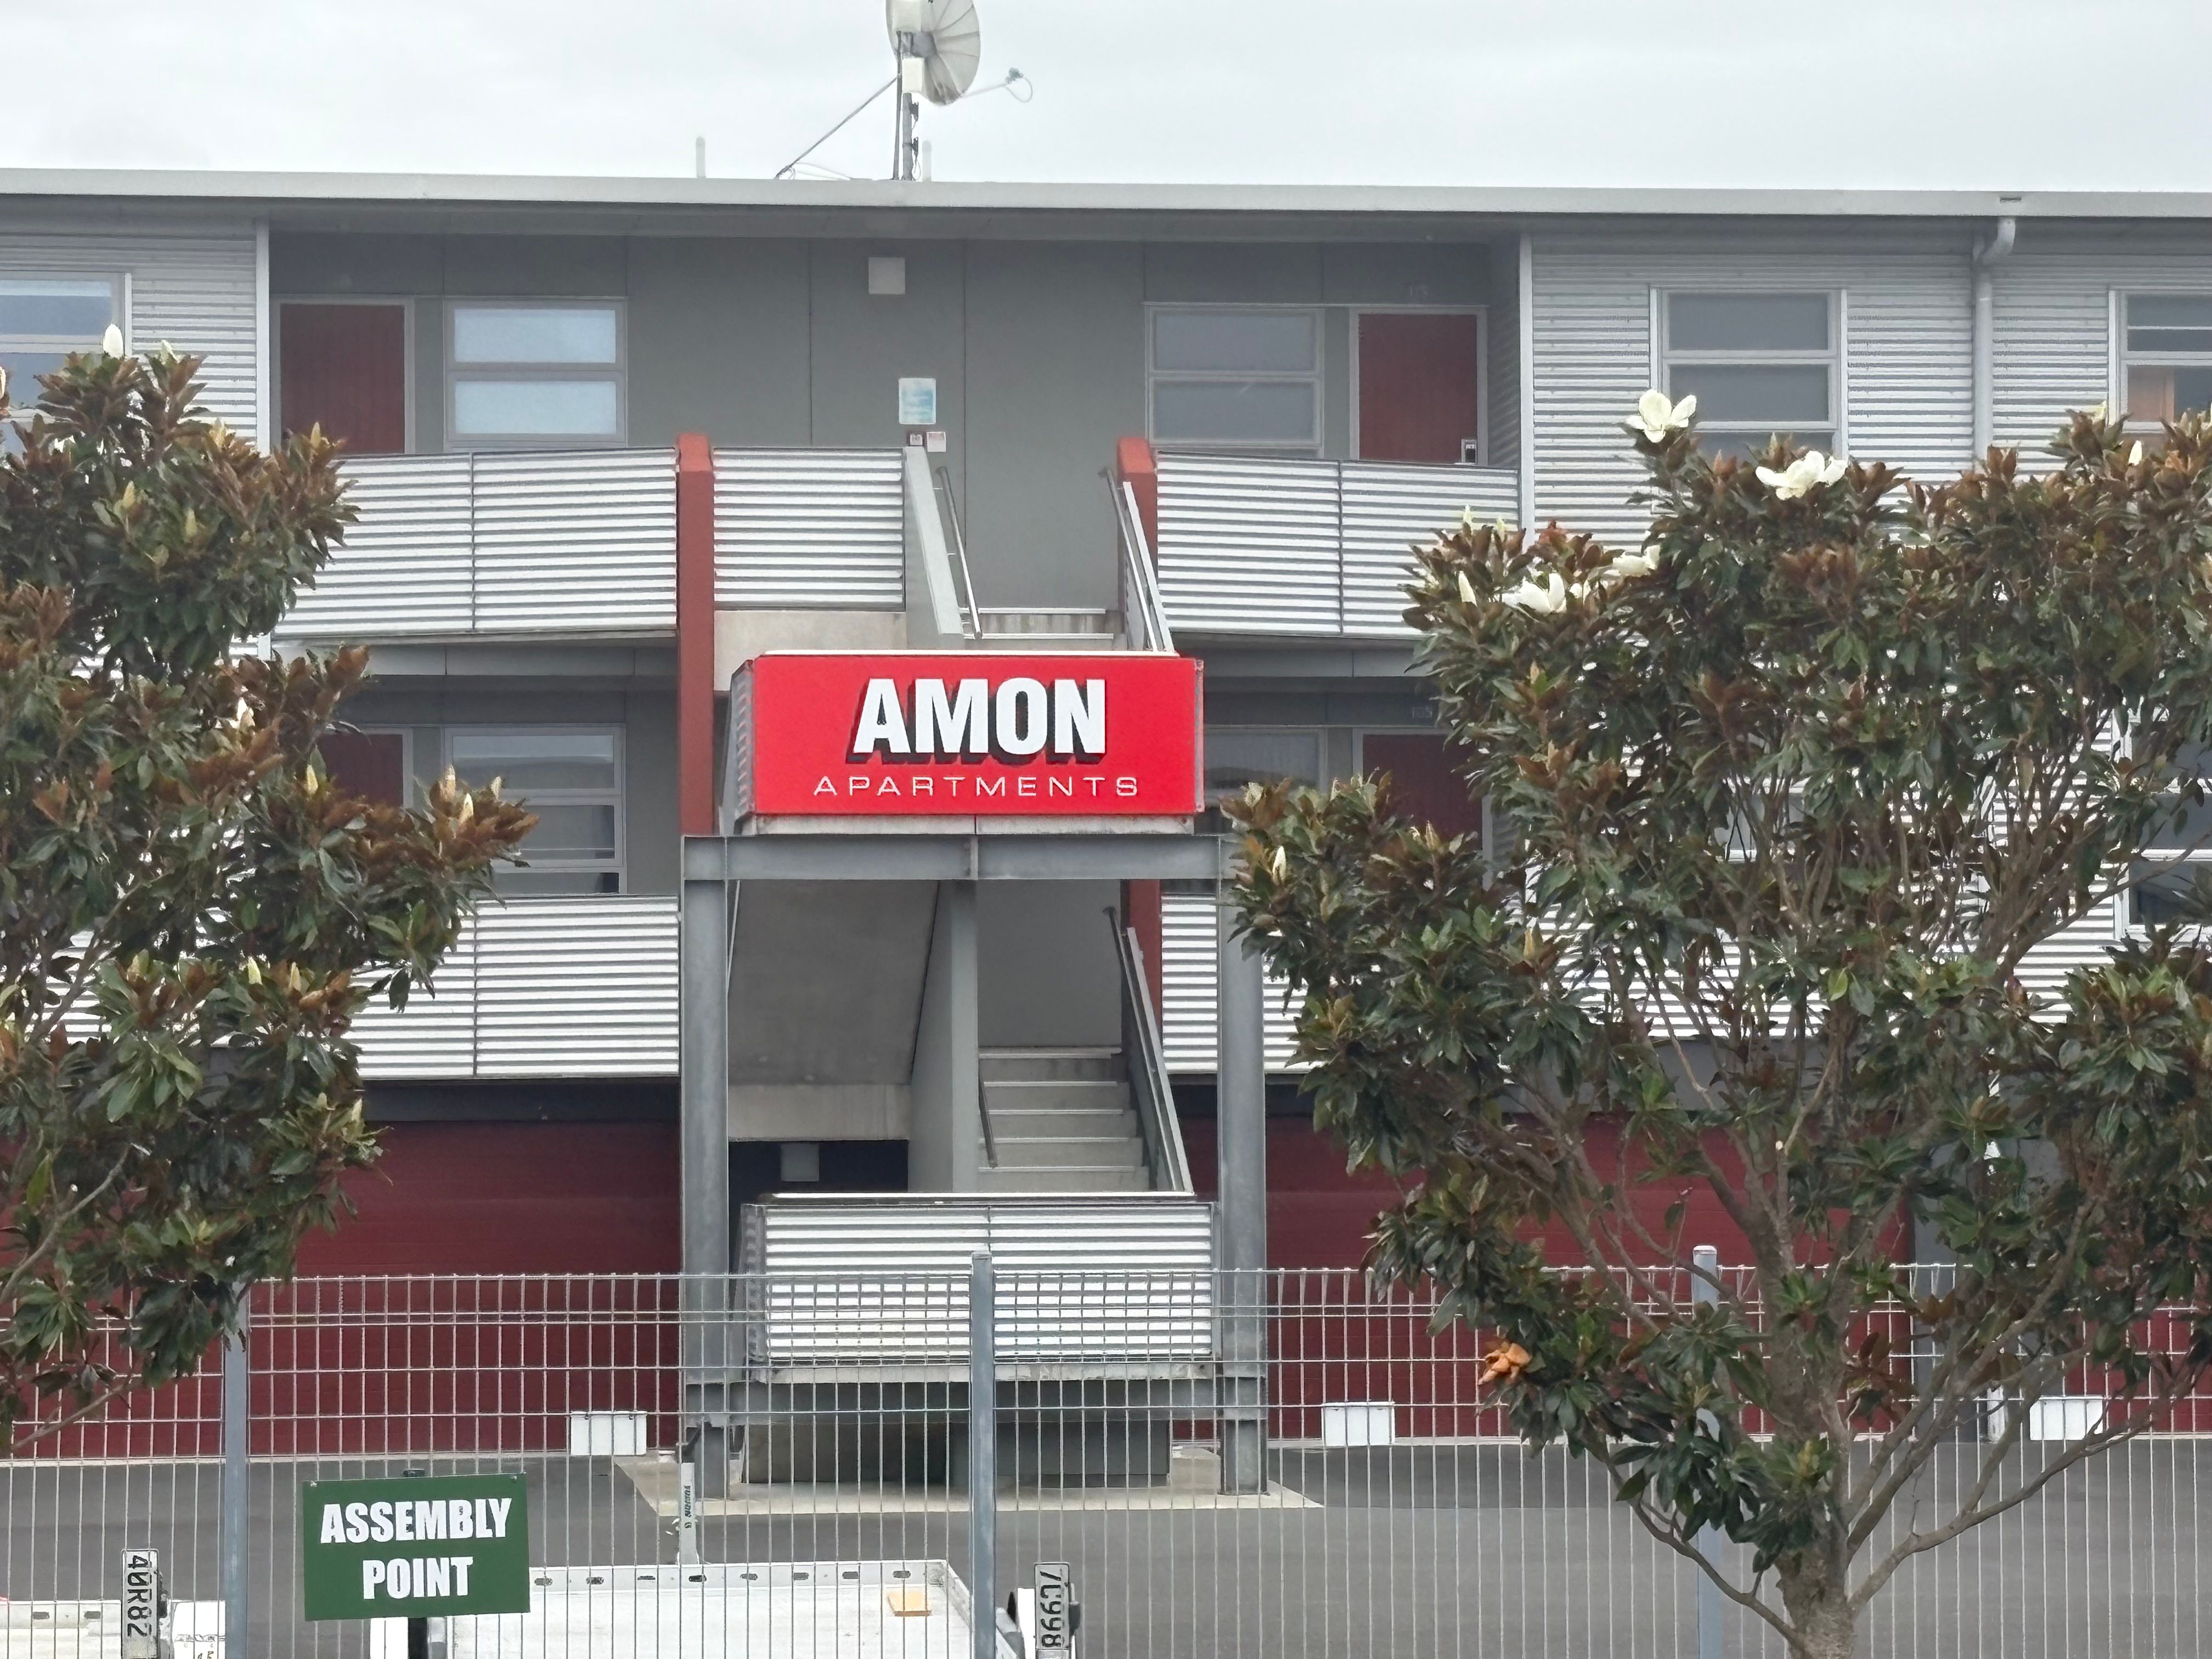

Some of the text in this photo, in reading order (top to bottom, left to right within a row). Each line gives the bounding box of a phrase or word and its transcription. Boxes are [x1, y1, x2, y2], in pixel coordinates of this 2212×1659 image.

[852, 676, 1106, 755] AMON
[813, 776, 1138, 797] APARTMENTS
[320, 1498, 512, 1544] ASSEMBLY
[362, 1556, 474, 1600] POINT
